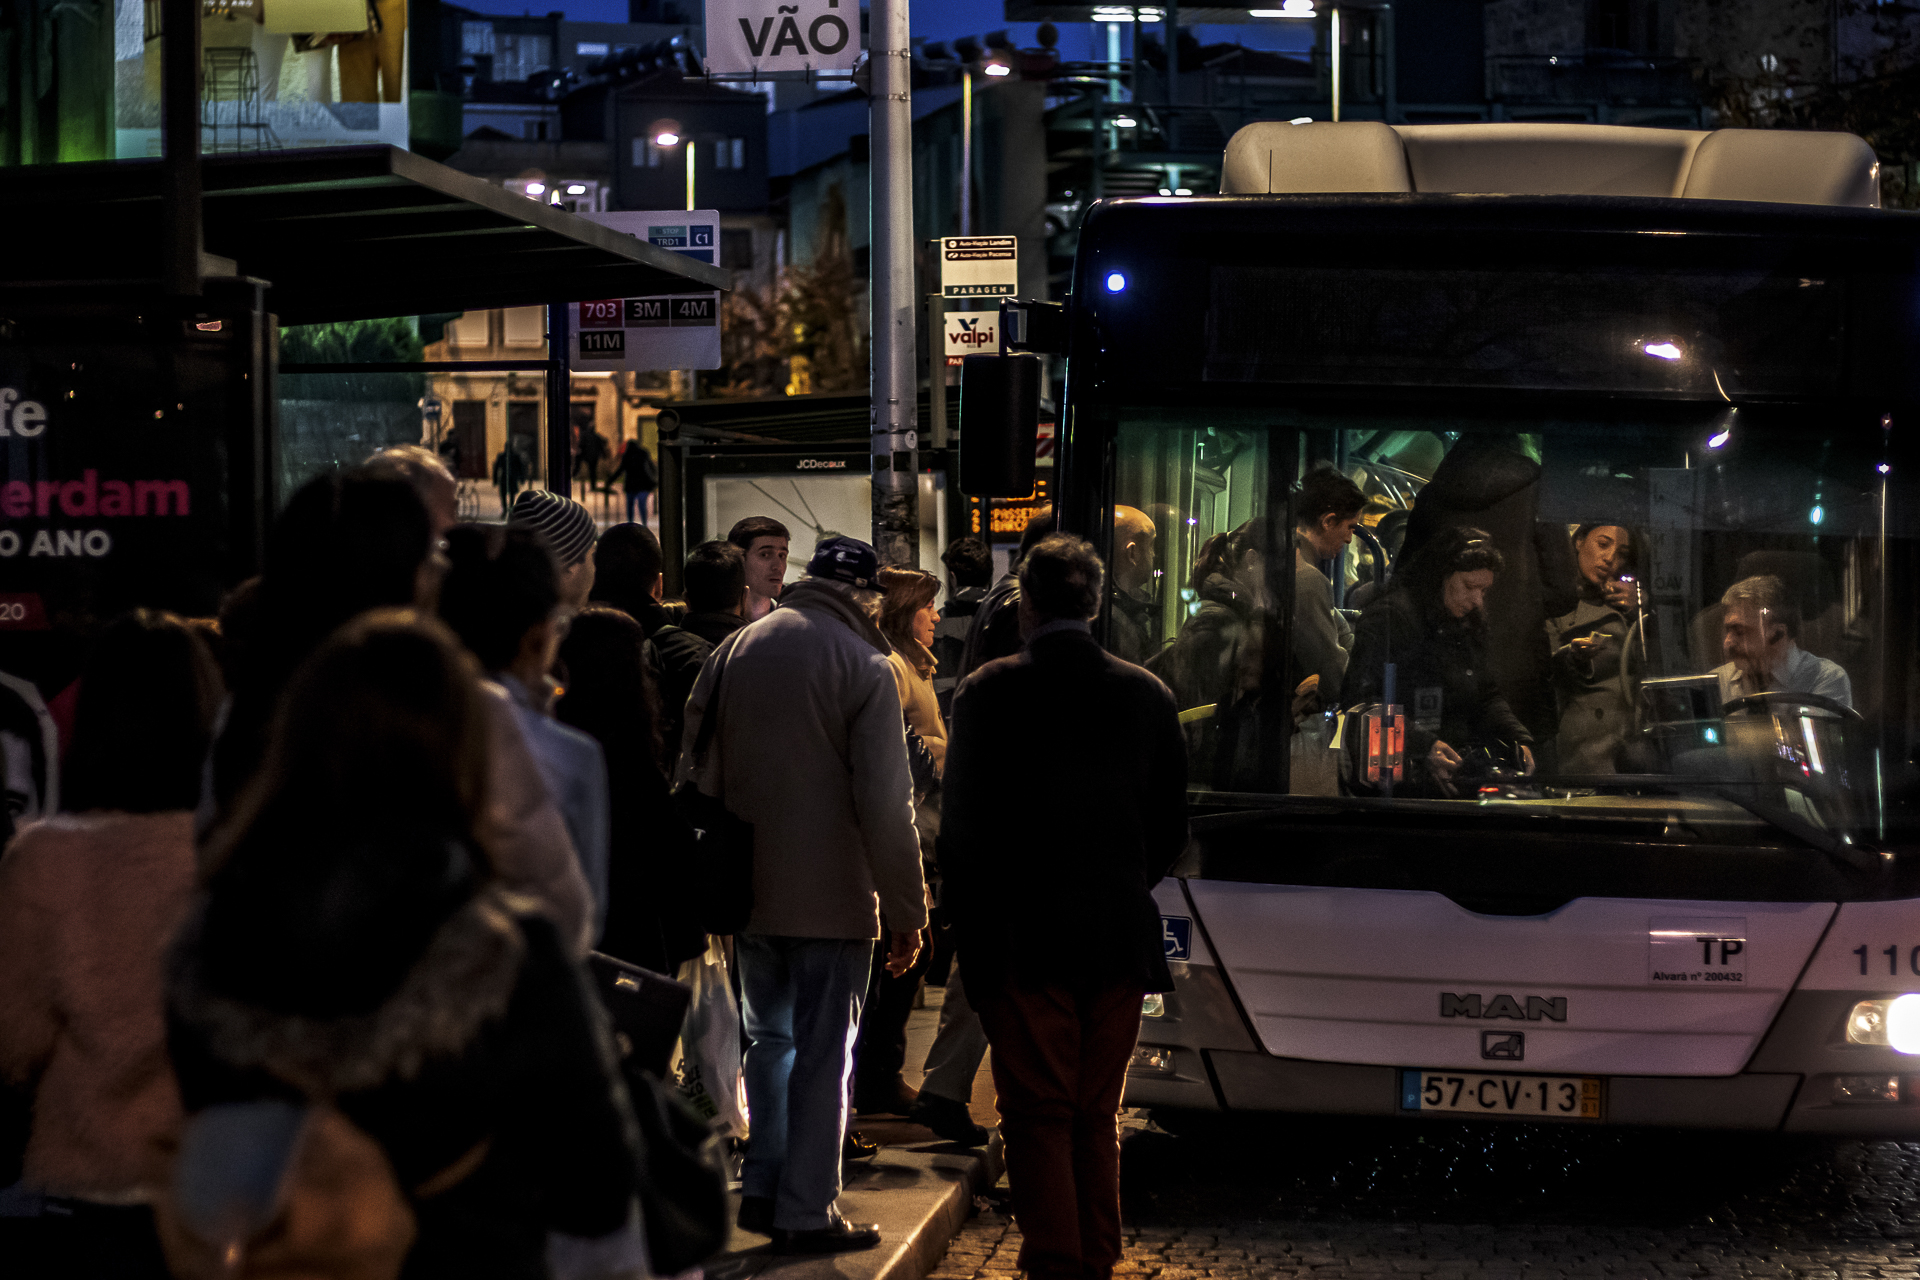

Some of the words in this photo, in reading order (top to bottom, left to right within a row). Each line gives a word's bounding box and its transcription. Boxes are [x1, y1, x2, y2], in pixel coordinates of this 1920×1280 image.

[738, 5, 850, 57] VÃO
[657, 238, 680, 246] TRD1
[695, 233, 709, 244] C1
[953, 286, 1007, 294] PARAGEM
[585, 303, 617, 318] 703
[633, 302, 661, 317] 3M
[679, 301, 708, 317] 4M
[584, 333, 620, 350] 11M
[949, 322, 994, 348] valpi
[796, 459, 846, 469] JCDecaux
[1, 469, 191, 517] erdam
[28, 529, 112, 557] ANO
[1697, 937, 1743, 965] TP
[1653, 972, 1687, 981] Alvará
[1705, 973, 1743, 982] 200432
[1441, 992, 1568, 1021] MAN
